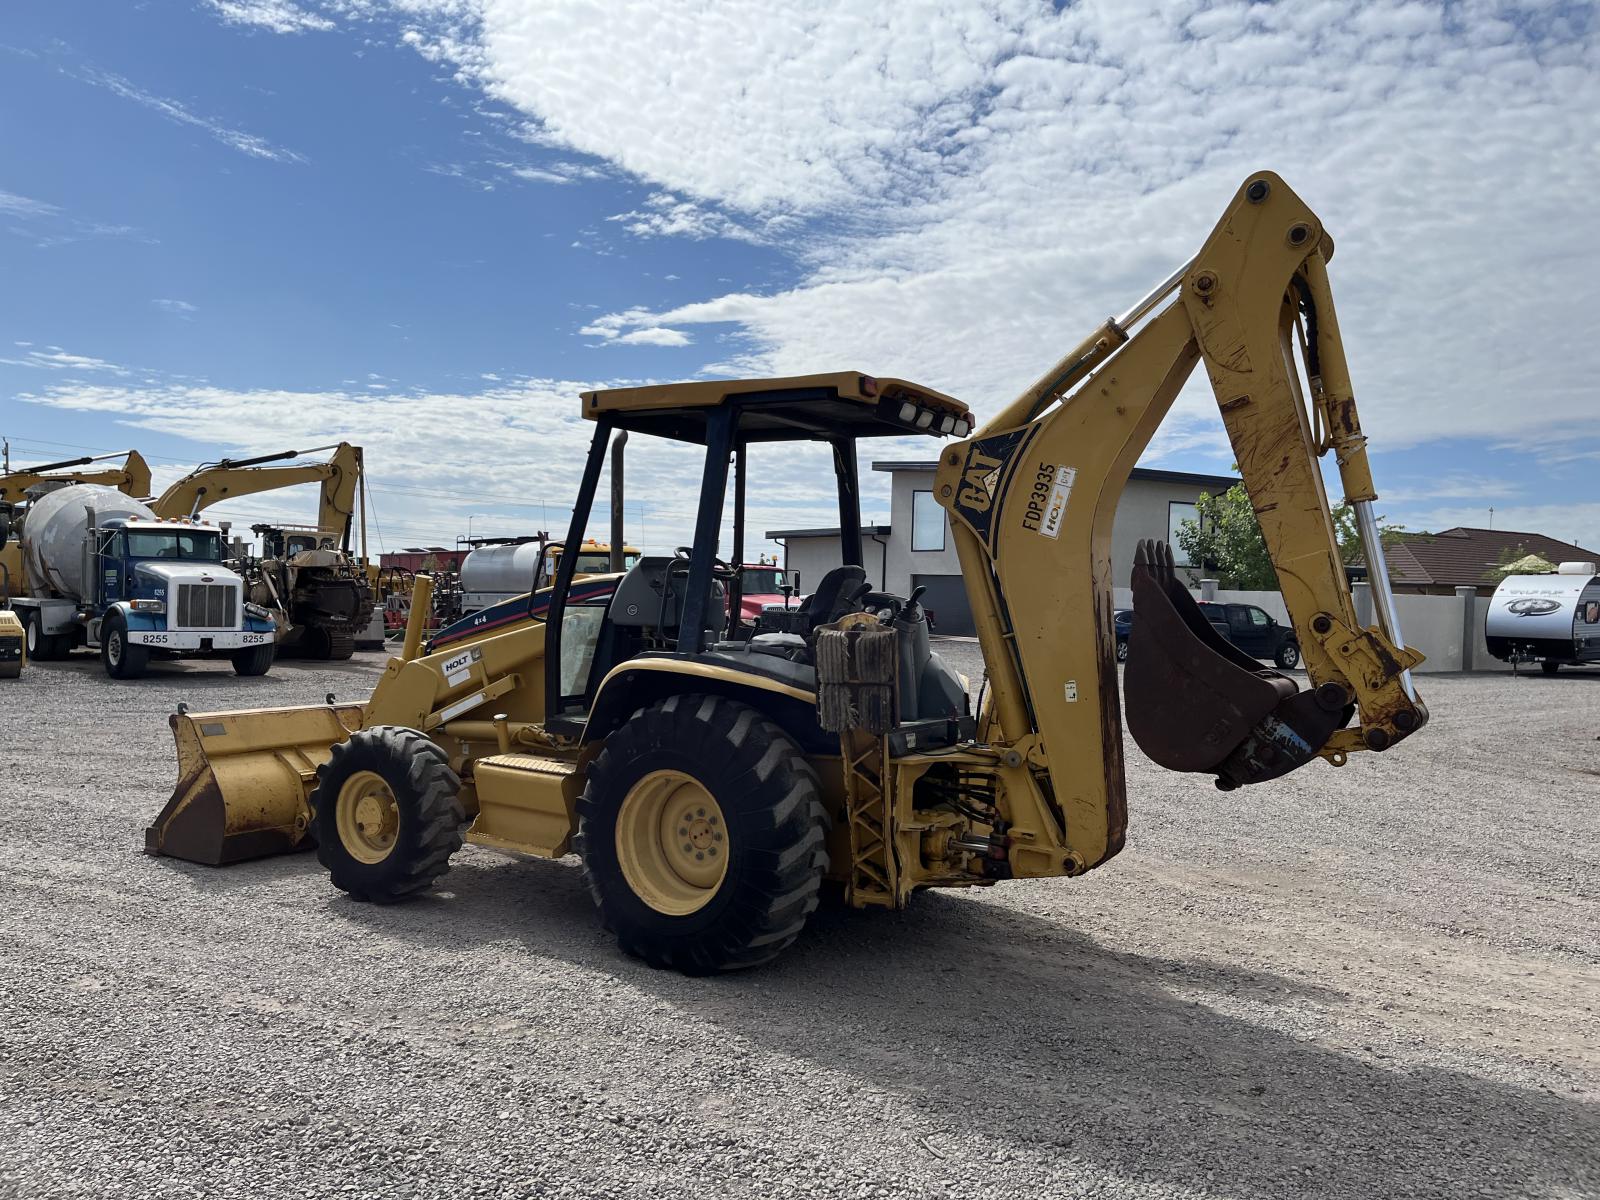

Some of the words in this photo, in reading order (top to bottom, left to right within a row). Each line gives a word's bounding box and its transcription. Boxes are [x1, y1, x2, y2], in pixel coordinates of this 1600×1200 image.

[959, 448, 1003, 512] CAT
[1022, 462, 1056, 531] FDP3935
[1046, 490, 1064, 531] HOLT
[474, 615, 487, 626] 4x4
[142, 634, 168, 644] 8255
[242, 634, 265, 643] 8255
[445, 655, 469, 672] HOLT
